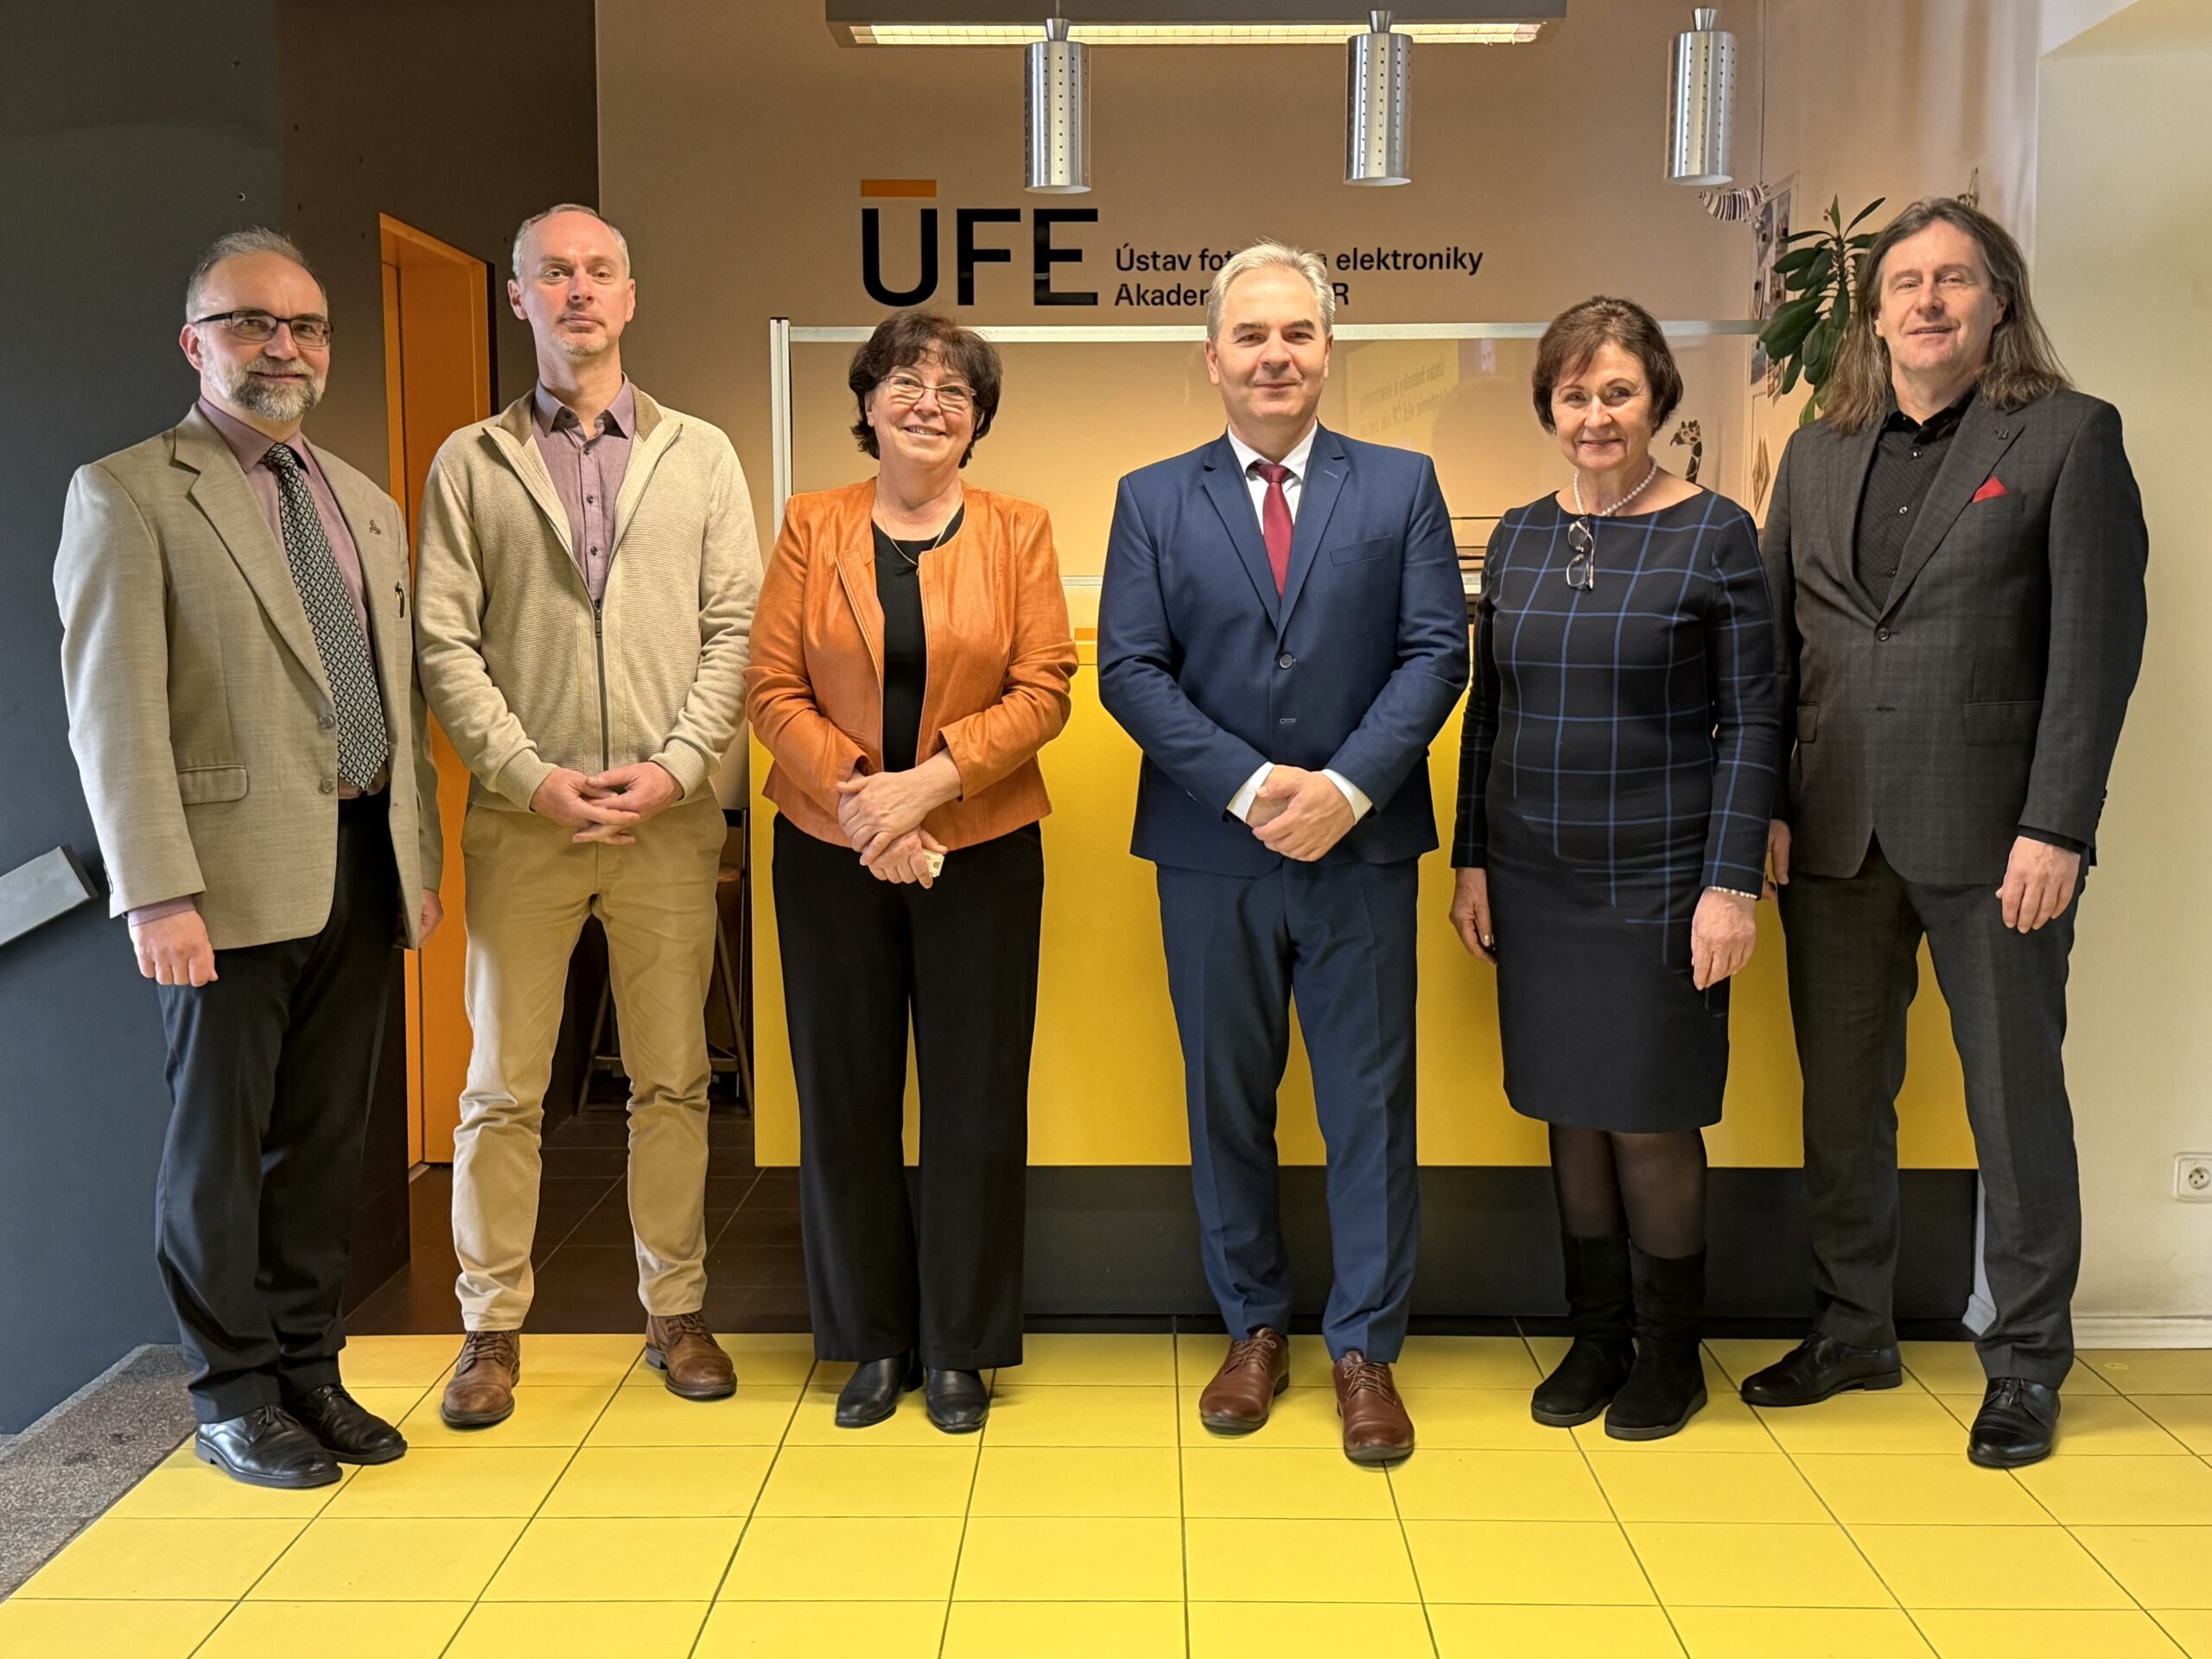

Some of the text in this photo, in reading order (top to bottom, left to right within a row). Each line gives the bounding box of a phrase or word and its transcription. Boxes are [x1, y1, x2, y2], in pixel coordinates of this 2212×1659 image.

[1116, 243, 1192, 271] Ústav
[1336, 247, 1484, 276] elektroniky
[1114, 283, 1349, 306] Akade R
